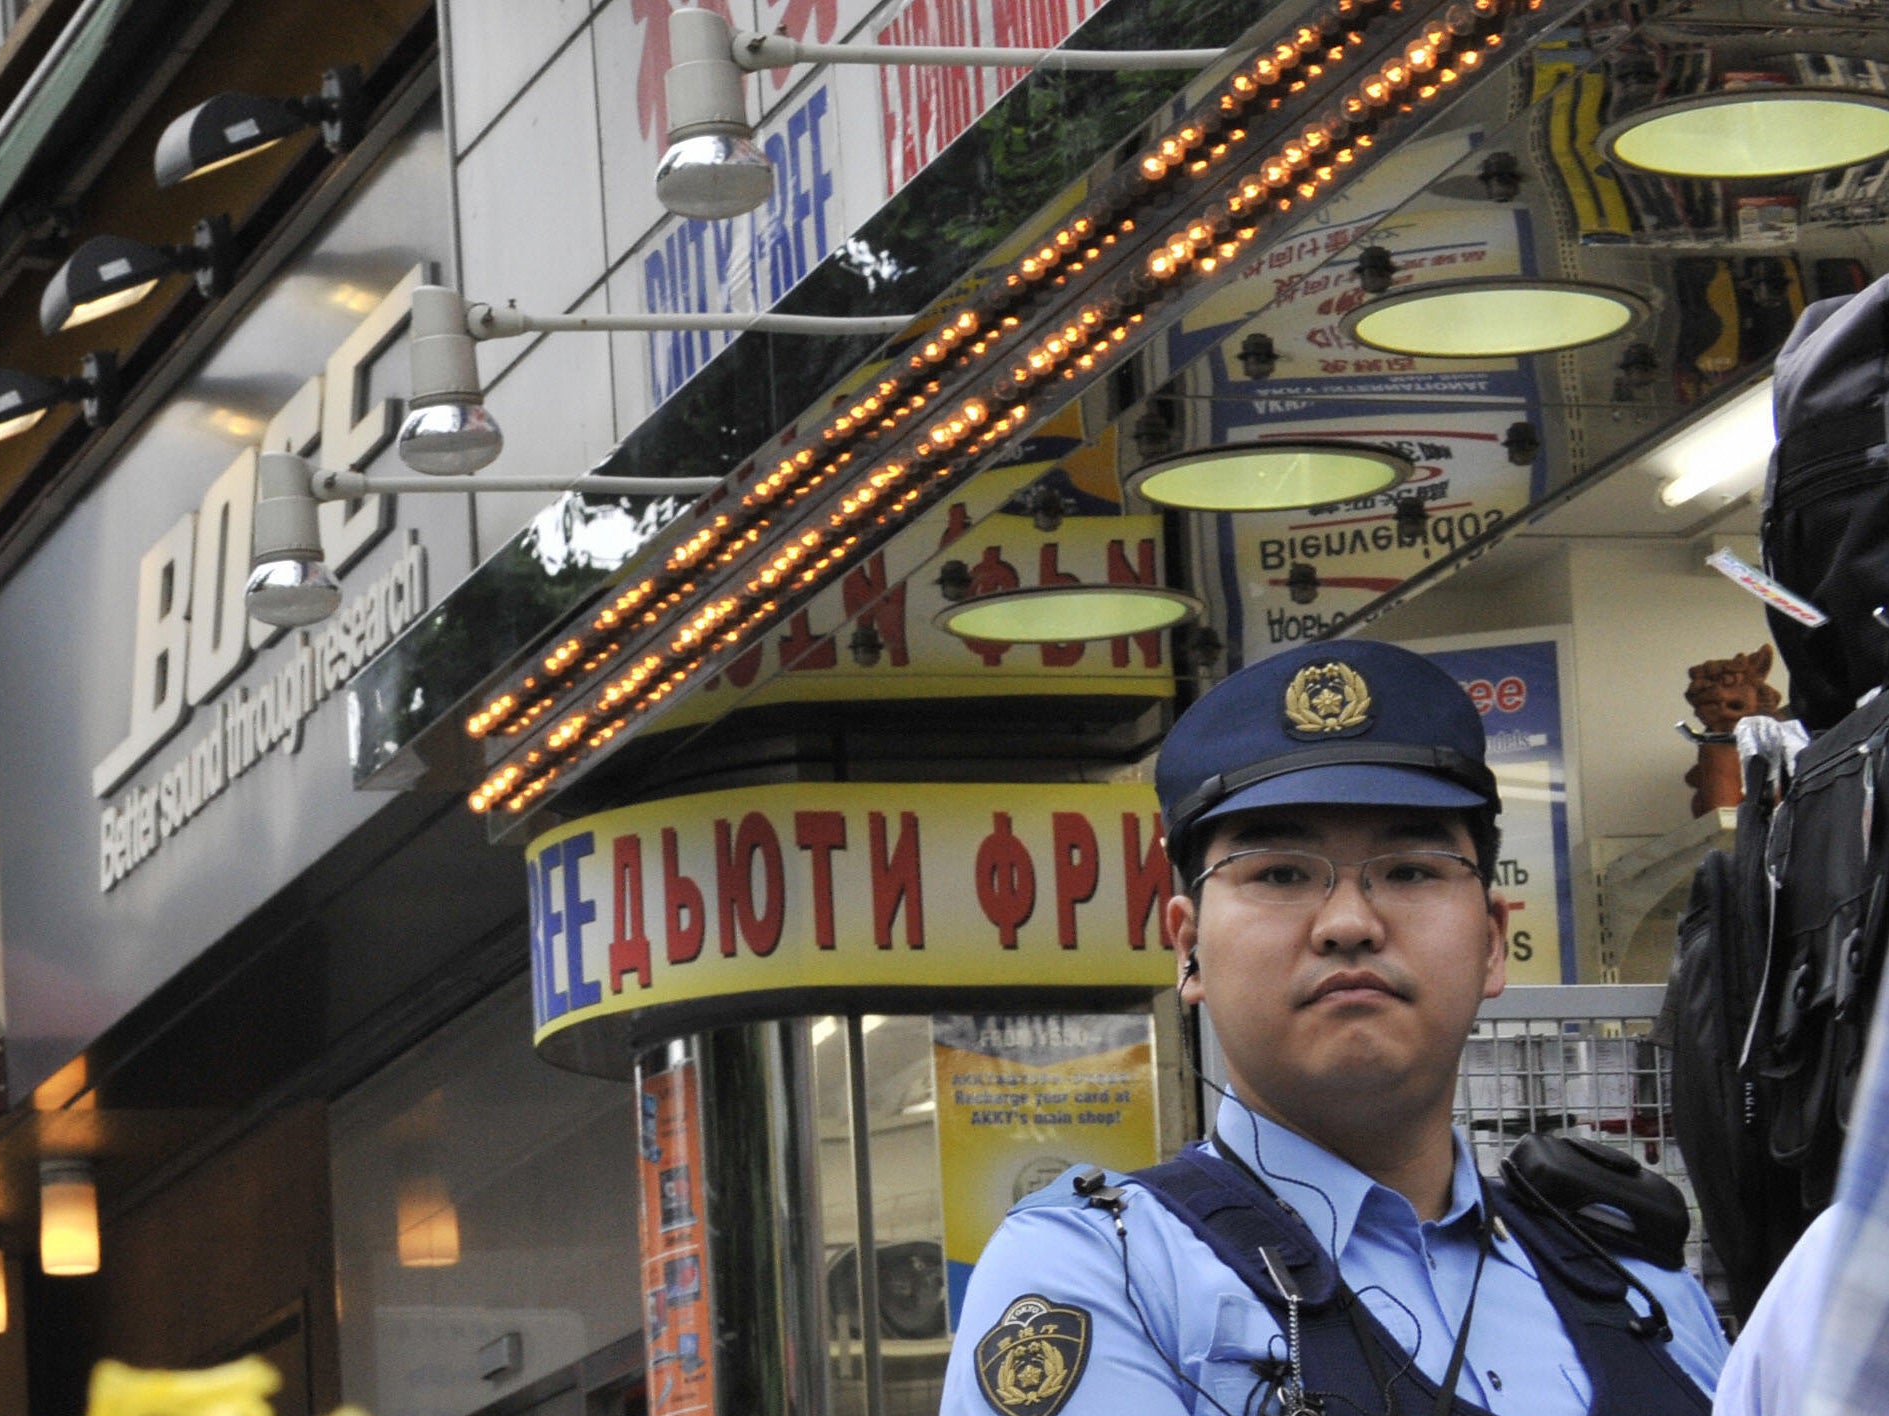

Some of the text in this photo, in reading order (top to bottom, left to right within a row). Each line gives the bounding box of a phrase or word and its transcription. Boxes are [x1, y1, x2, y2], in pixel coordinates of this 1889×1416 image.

[100, 528, 428, 895] Better sound through research
[609, 811, 925, 994] ДЬЮТИ
[954, 1089, 1028, 1108] Recharge
[1074, 1089, 1111, 1104] card
[1114, 1089, 1132, 1104] at
[1033, 1111, 1073, 1125] main
[1077, 1108, 1121, 1127] shop!
